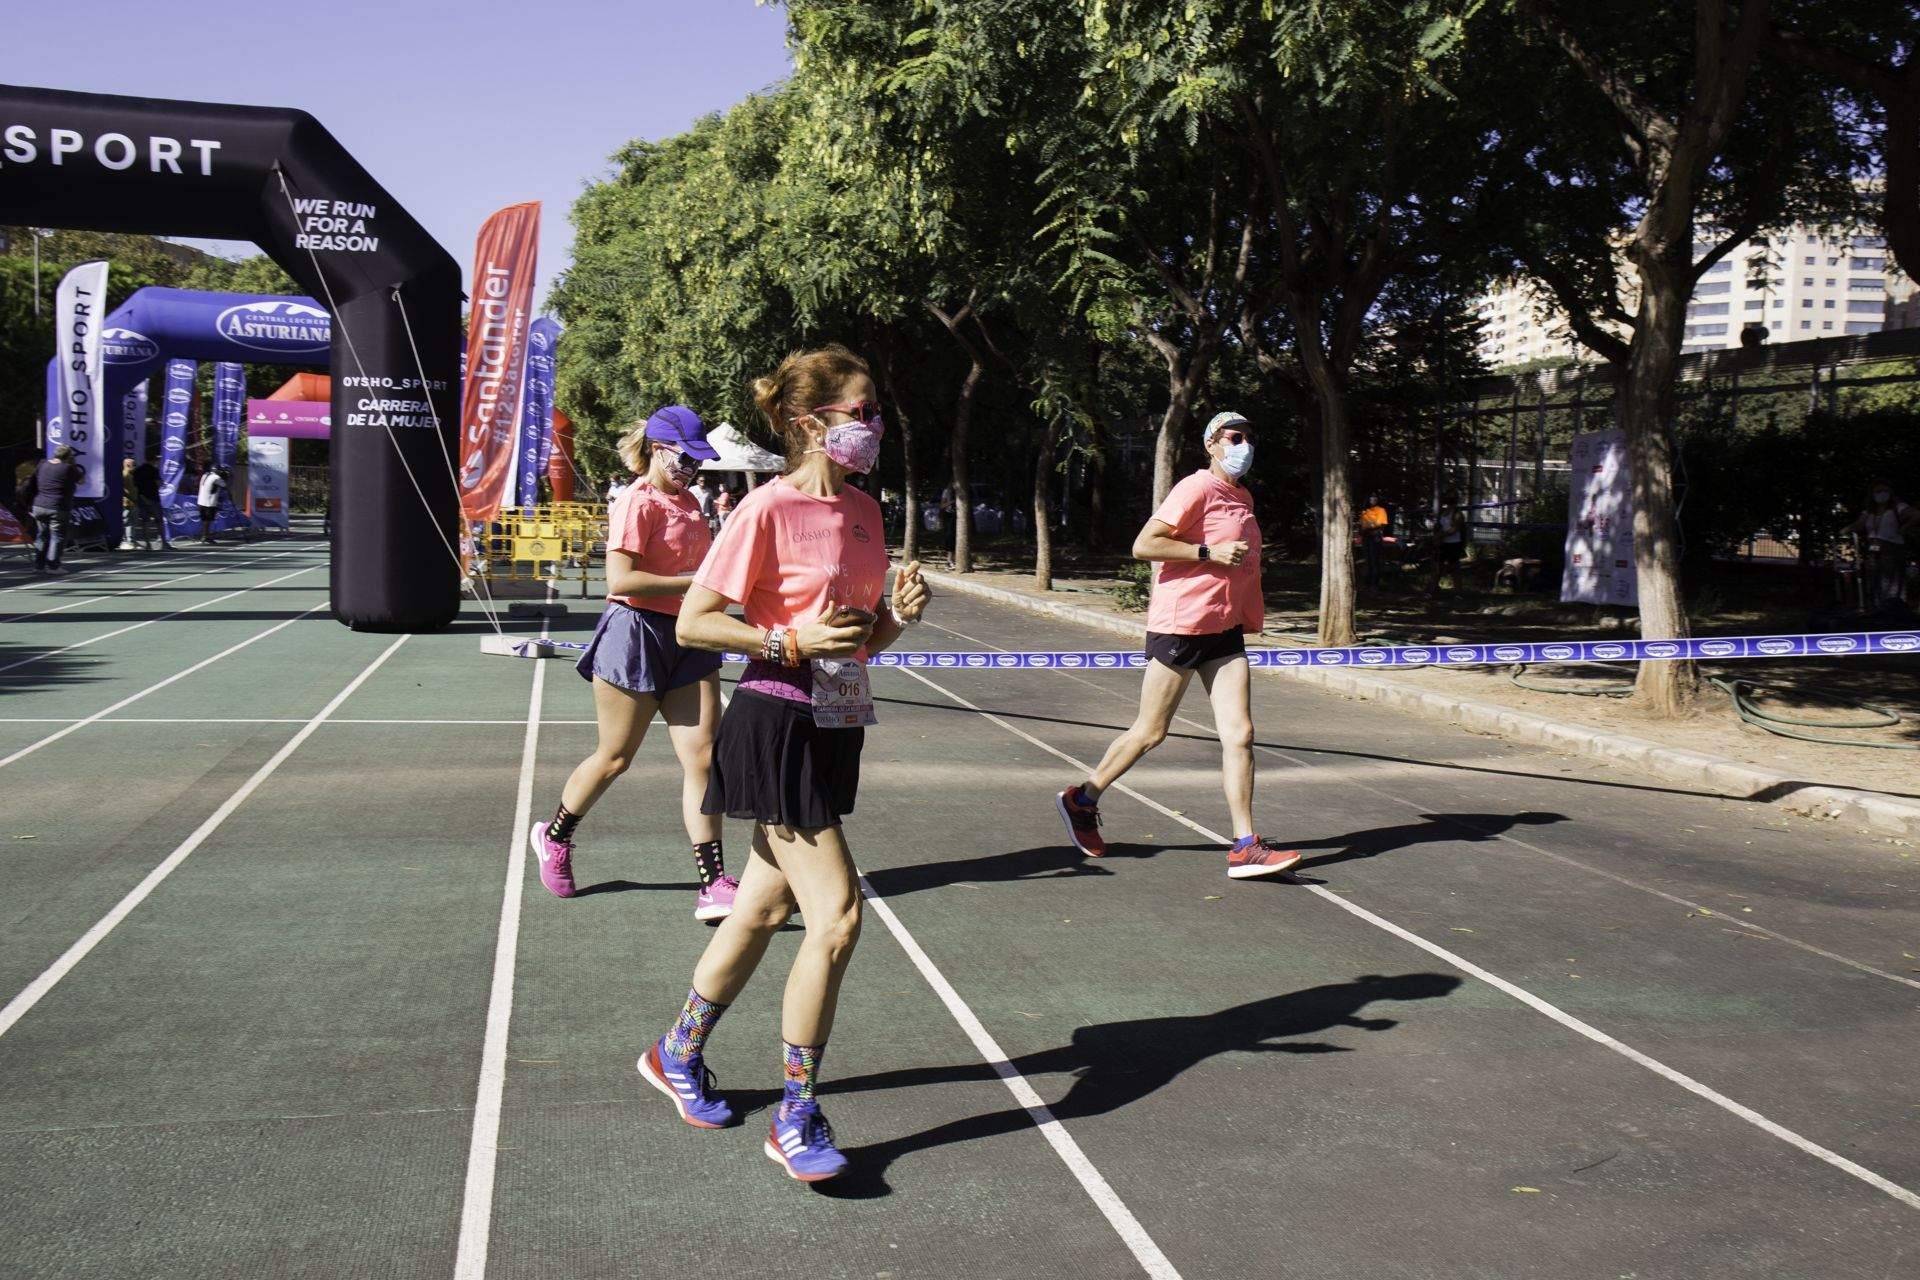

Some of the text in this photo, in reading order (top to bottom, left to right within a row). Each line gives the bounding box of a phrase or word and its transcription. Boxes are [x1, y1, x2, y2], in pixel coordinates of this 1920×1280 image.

[294, 198, 376, 219] WE RUN
[305, 216, 366, 234] FOR A
[295, 233, 379, 252] REASON
[468, 261, 510, 444] Santander
[342, 376, 449, 391] OYSHO_SPORT
[357, 398, 431, 413] CARRERA
[346, 413, 442, 429] DE LA MUJER
[792, 528, 831, 543] OYSHO
[823, 563, 848, 577] WE
[828, 583, 873, 600] RUN
[838, 682, 860, 697] 016
